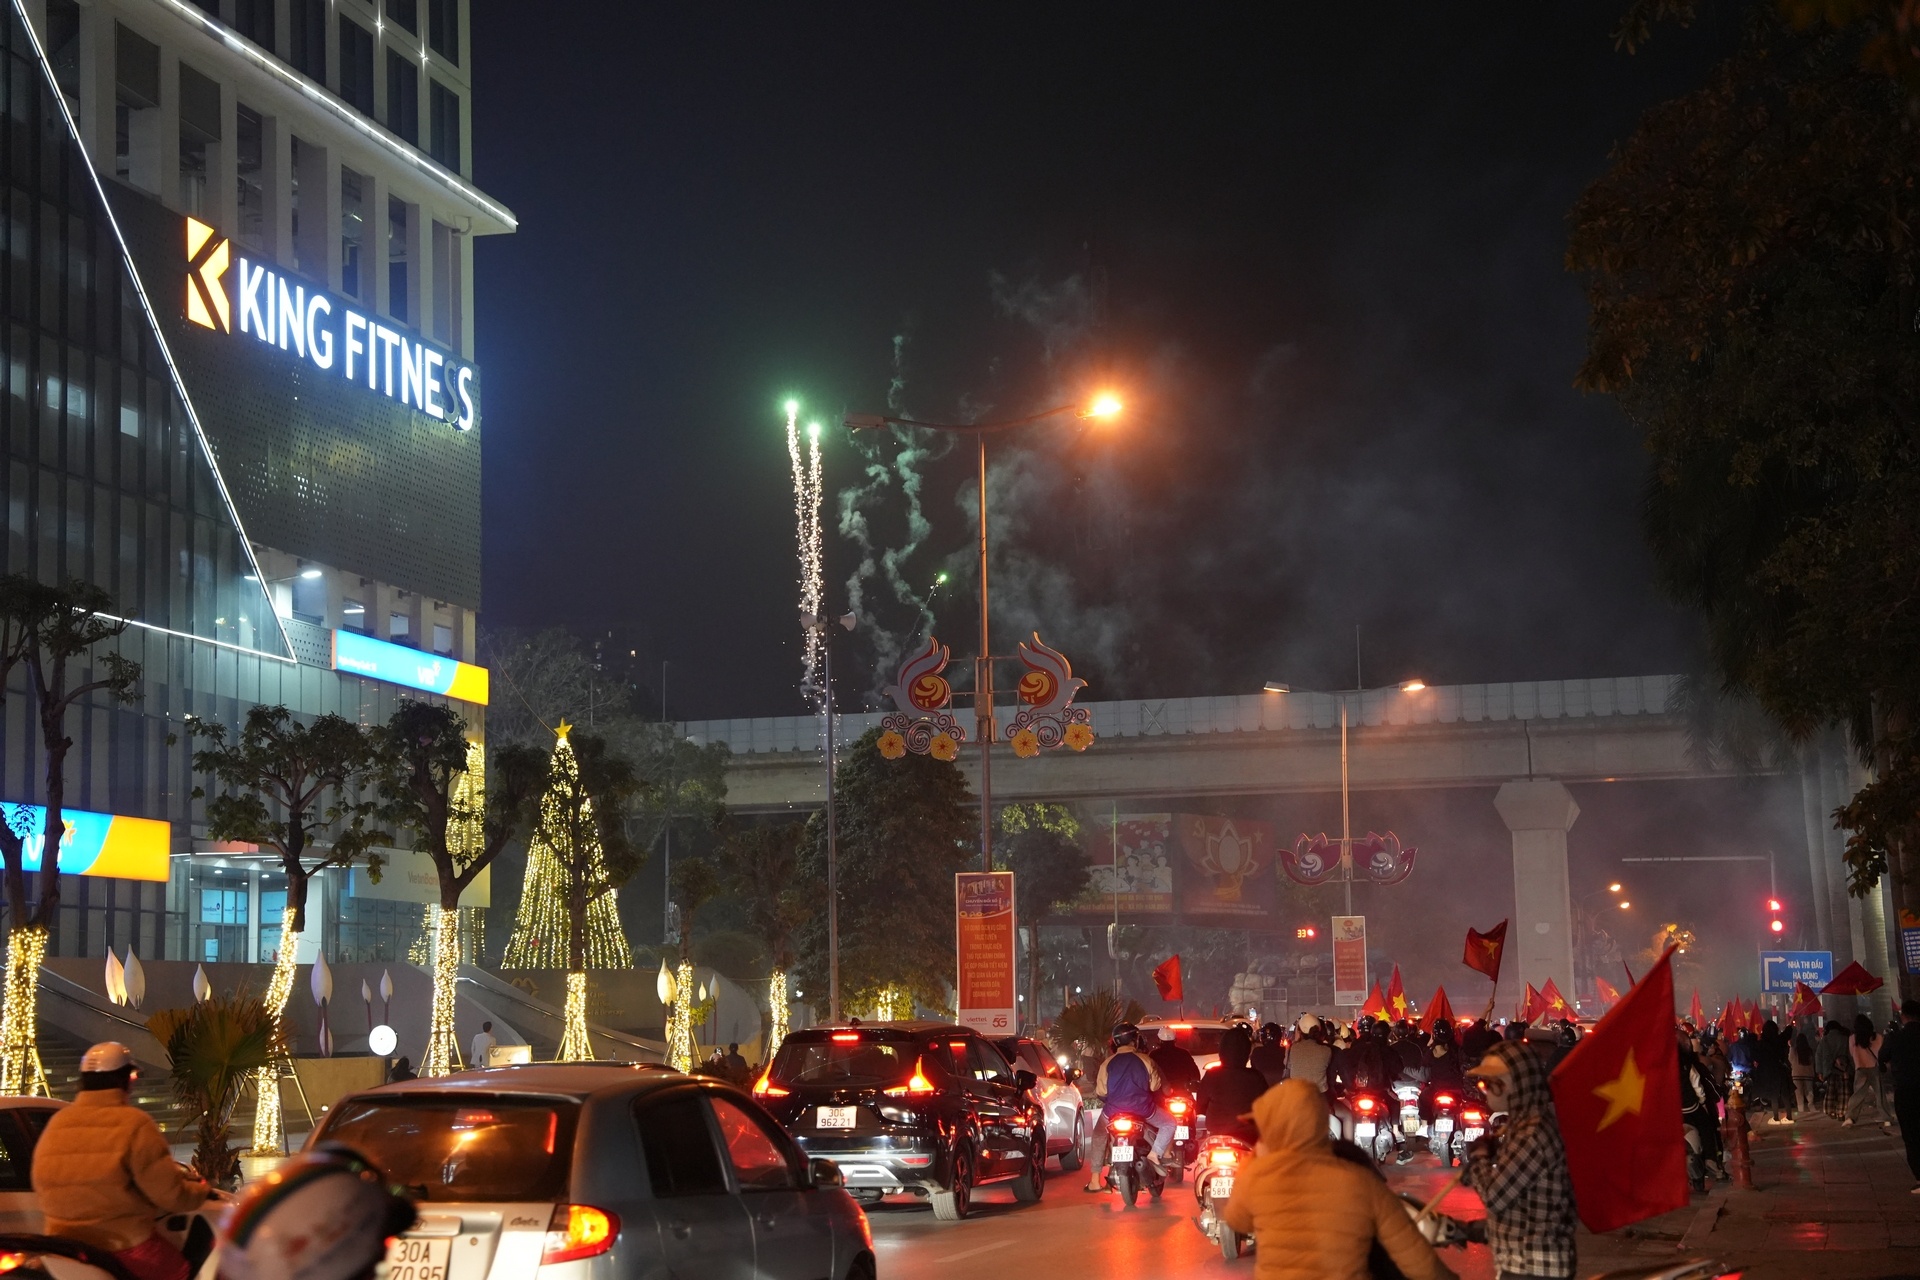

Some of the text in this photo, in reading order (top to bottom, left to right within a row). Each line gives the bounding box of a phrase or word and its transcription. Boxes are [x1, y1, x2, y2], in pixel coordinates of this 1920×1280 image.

[239, 257, 474, 432] KING FITNESS
[1297, 929, 1307, 938] 33
[1788, 959, 1823, 969] NHÀ THI ĐẤU
[1792, 971, 1818, 980] HÀ ĐÔNG
[1780, 980, 1792, 989] Dong
[992, 1017, 1007, 1028] 5G
[821, 1118, 850, 1127] 962.21
[396, 1240, 431, 1264] 30A
